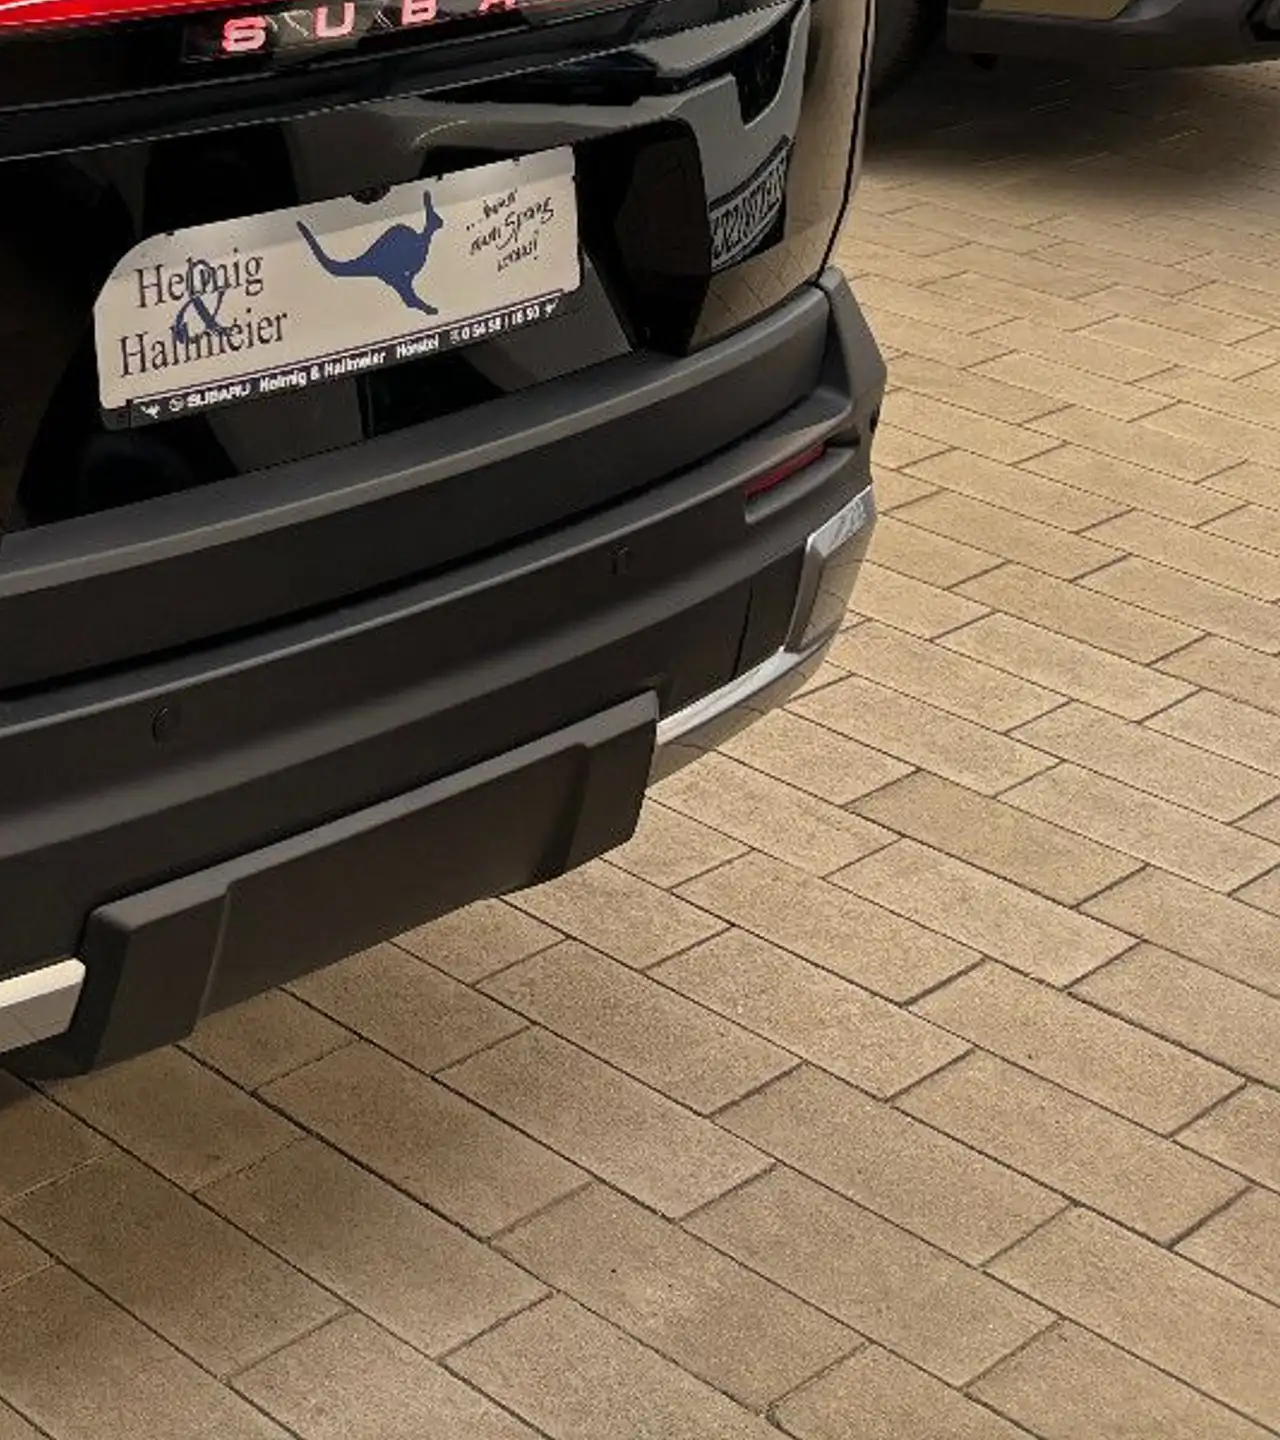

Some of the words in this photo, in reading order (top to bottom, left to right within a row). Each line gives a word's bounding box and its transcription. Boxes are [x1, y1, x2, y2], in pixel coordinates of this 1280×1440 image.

[133, 246, 264, 309] Helmig
[175, 259, 234, 344] &
[118, 307, 288, 378] Hallmeier
